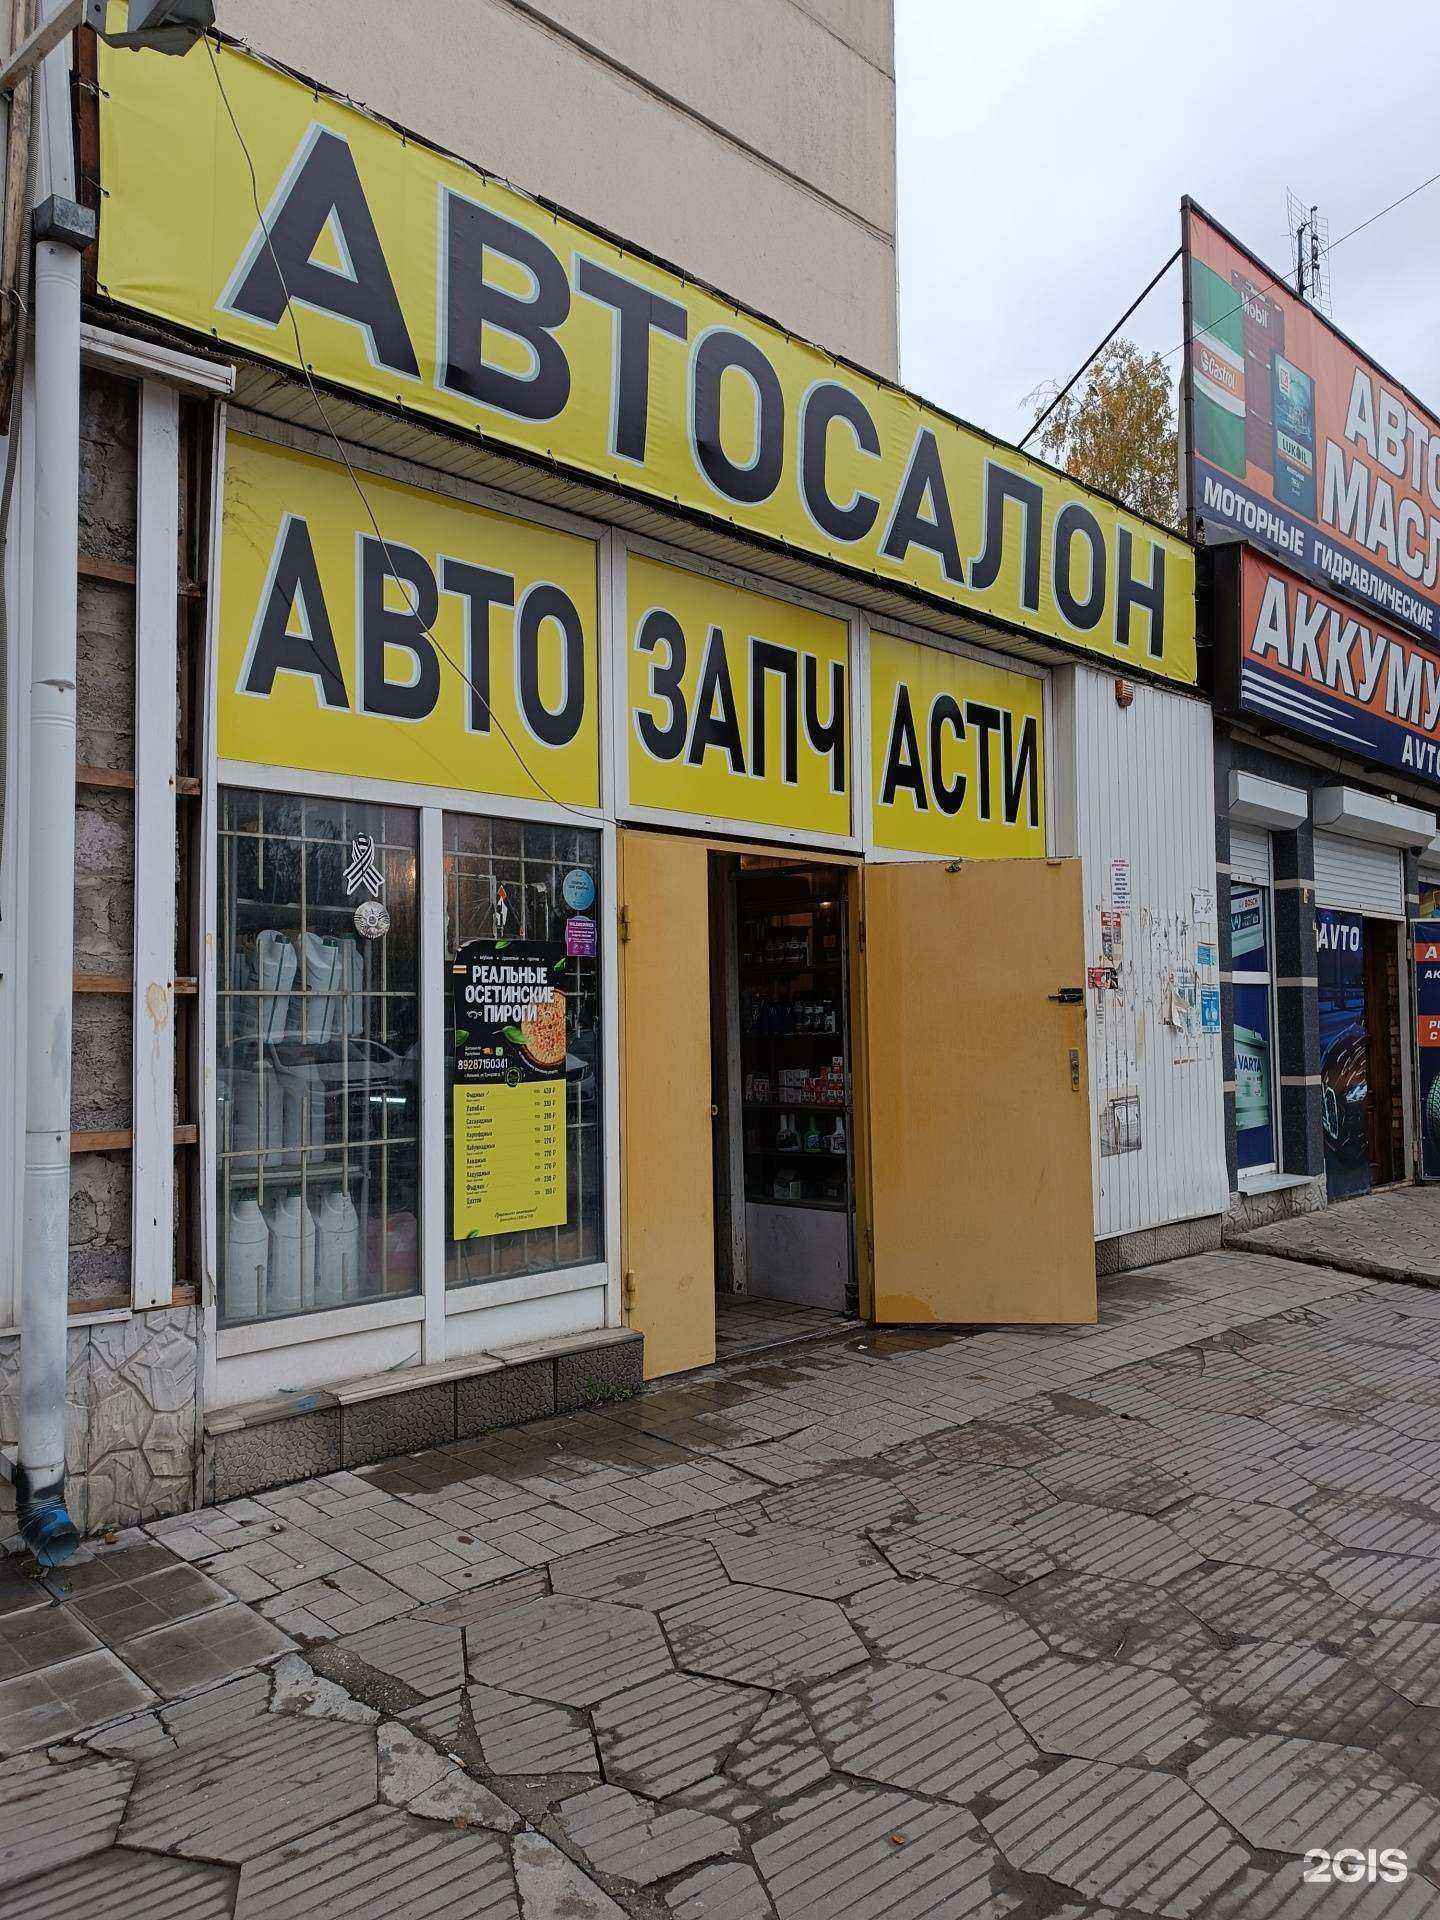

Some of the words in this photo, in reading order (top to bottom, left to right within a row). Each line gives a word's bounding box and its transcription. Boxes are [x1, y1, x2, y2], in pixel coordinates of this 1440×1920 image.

[1210, 357, 1236, 390] Castrol
[215, 121, 1167, 661] АВТОСАЛОН
[1203, 476, 1304, 558] МОТОРНЫЕ
[1313, 539, 1434, 632] ГИДРАВЛИЧЕСКИЕ
[235, 511, 585, 749] АВТО
[632, 606, 846, 795] ЗАПЧ
[878, 681, 1039, 829] АСТИ
[472, 965, 548, 984] РЕАЛЬНЫЕ
[465, 985, 554, 1003] ОСЕТИНСКИЕ
[483, 1004, 537, 1022] ПИРОГИ
[1237, 1054, 1263, 1073] VARTA
